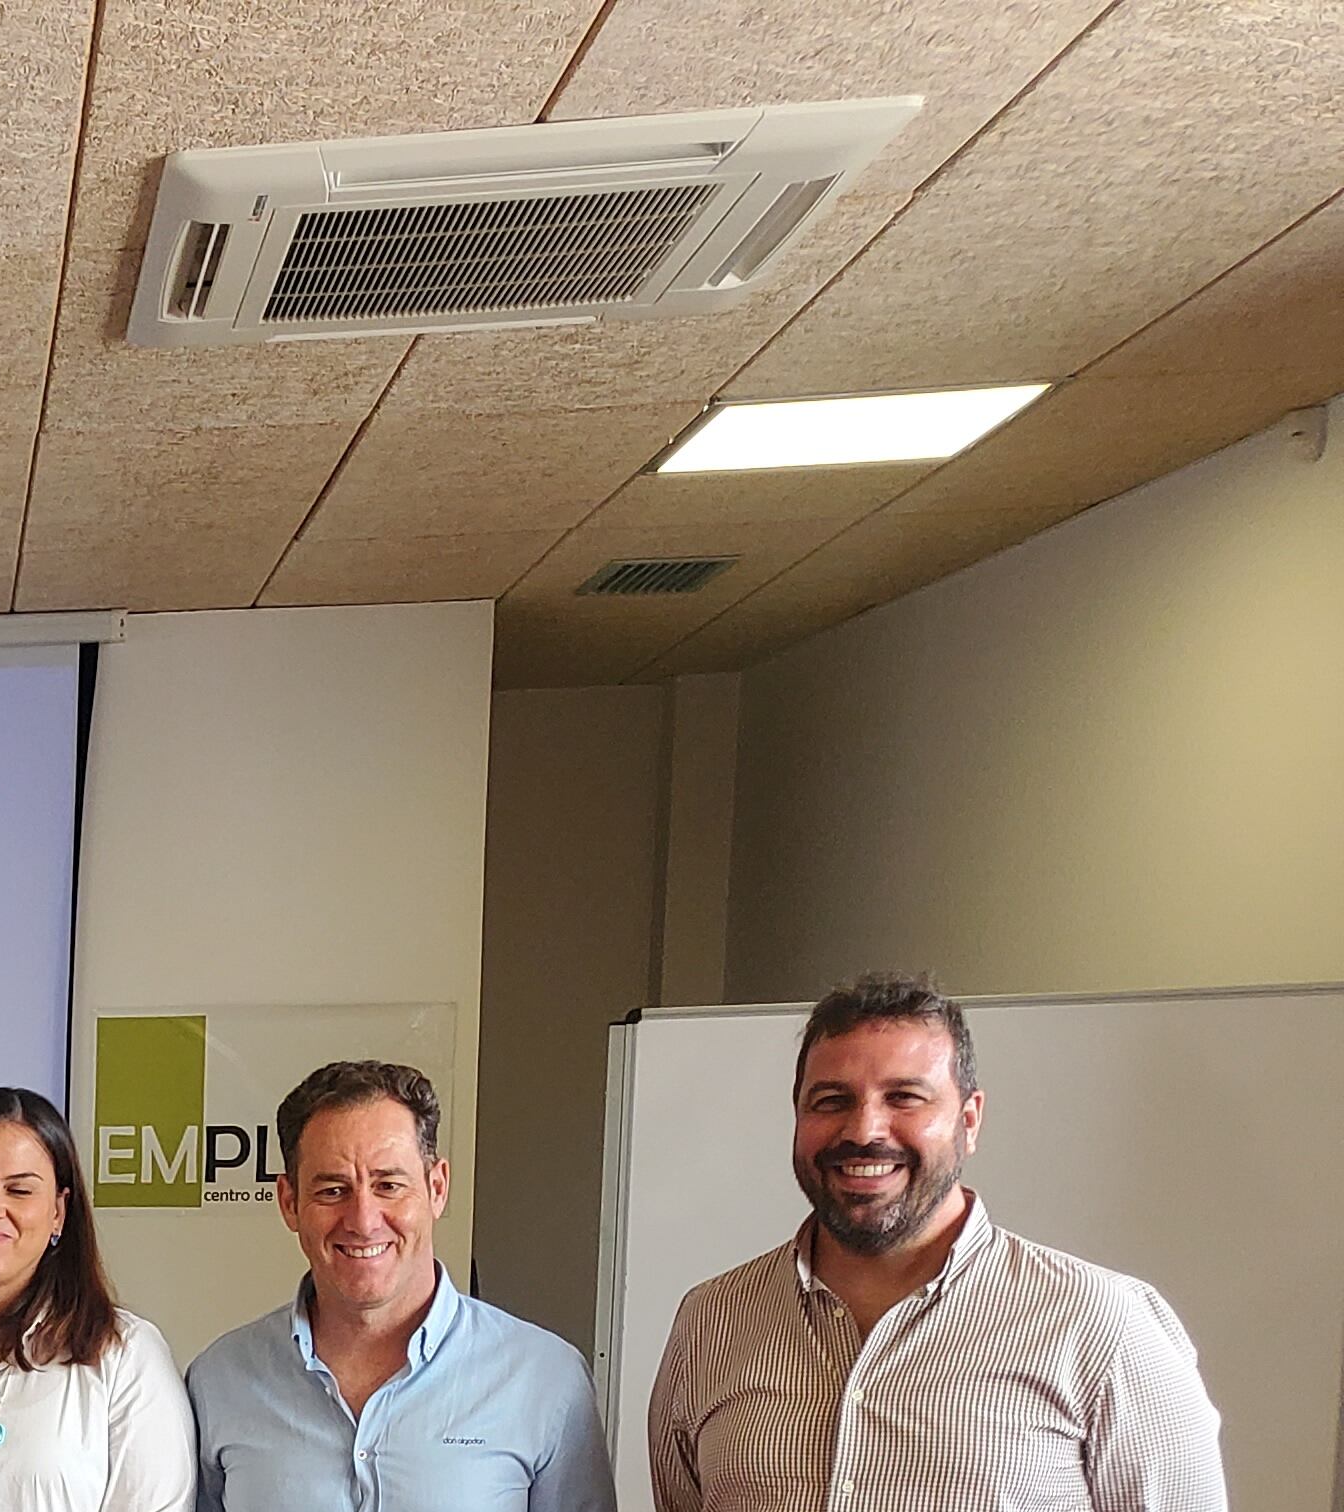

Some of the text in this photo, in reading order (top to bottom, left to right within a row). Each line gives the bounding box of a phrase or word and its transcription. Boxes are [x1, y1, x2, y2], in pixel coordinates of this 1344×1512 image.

[98, 1125, 288, 1183] EMPL
[203, 1187, 274, 1202] centro de
